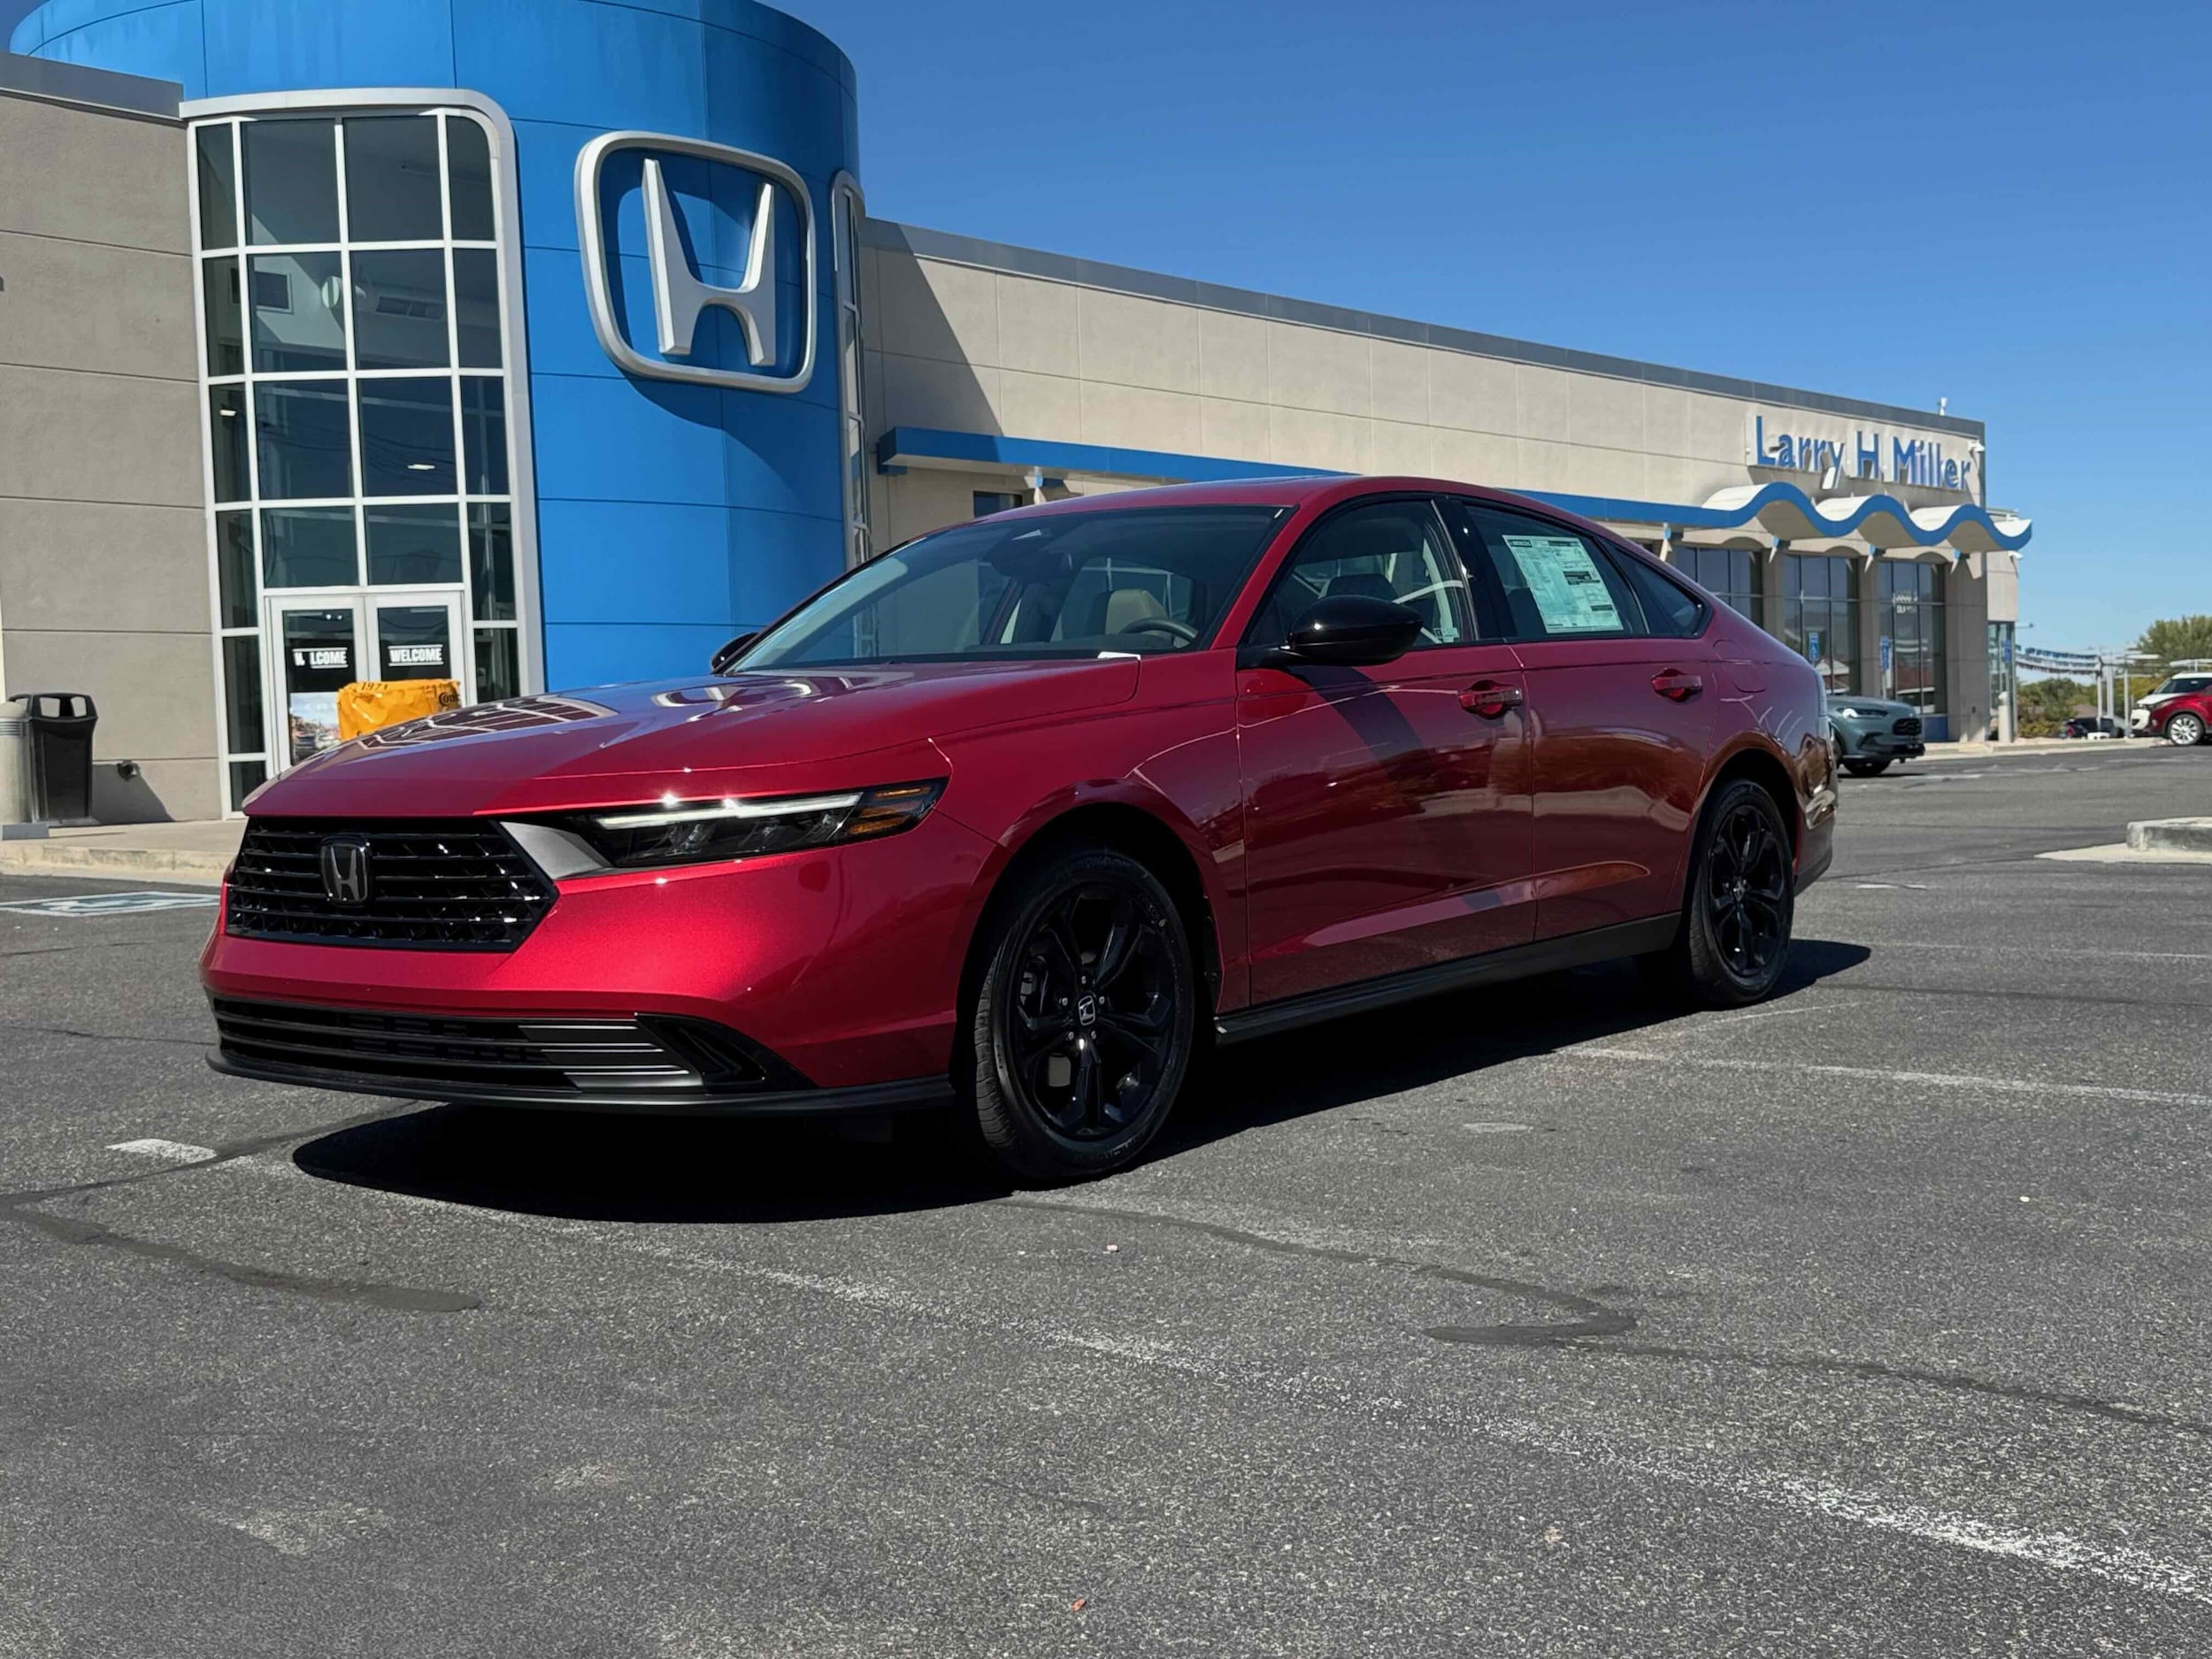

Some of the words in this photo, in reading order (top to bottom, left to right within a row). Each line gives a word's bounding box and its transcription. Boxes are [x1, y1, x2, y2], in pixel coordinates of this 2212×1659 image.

[644, 157, 777, 367] H
[1755, 415, 1846, 490] Larry
[1856, 429, 1880, 480] H
[1892, 434, 1972, 491] Miller
[293, 649, 348, 667] WLCOME
[388, 647, 443, 664] WELCOME
